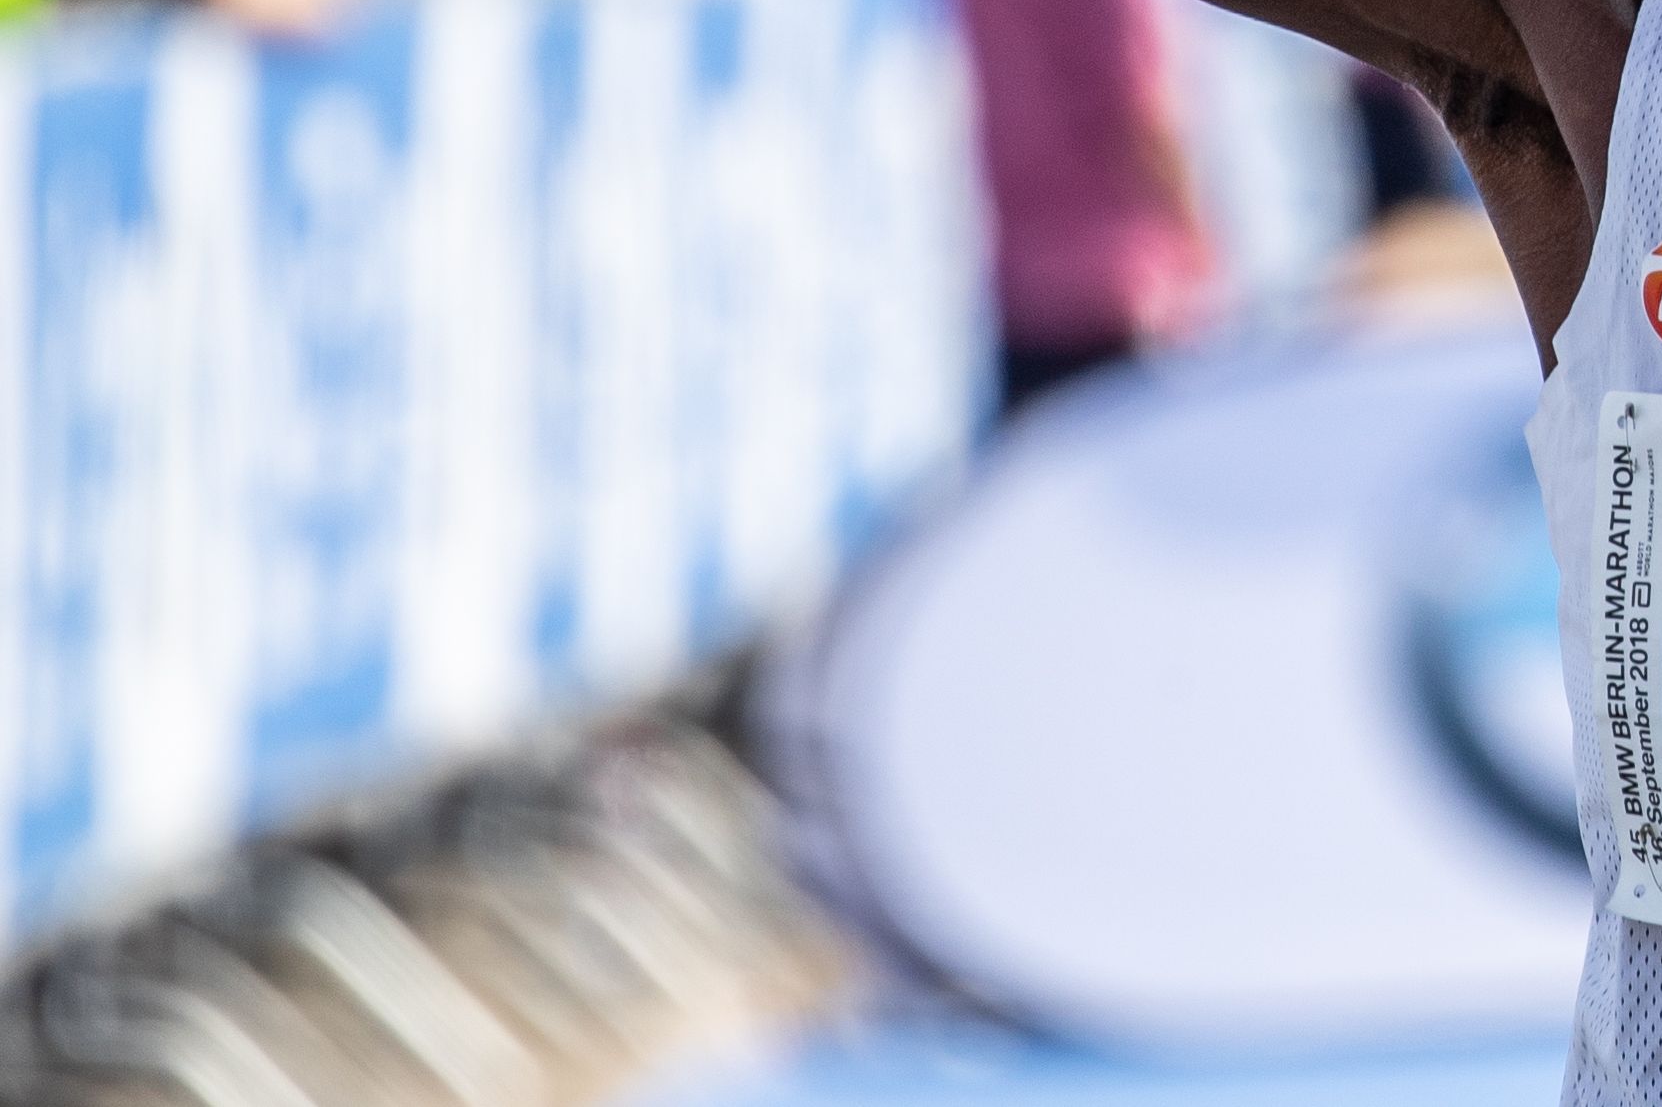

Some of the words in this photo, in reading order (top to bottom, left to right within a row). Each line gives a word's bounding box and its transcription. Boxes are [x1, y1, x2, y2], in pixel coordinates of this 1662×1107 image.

[1647, 489, 1655, 542] MARATHON
[1605, 445, 1634, 740] BERLIN-MARATHON
[1629, 617, 1649, 682] 2018
[1616, 745, 1643, 817] BMW
[1634, 686, 1662, 825] September
